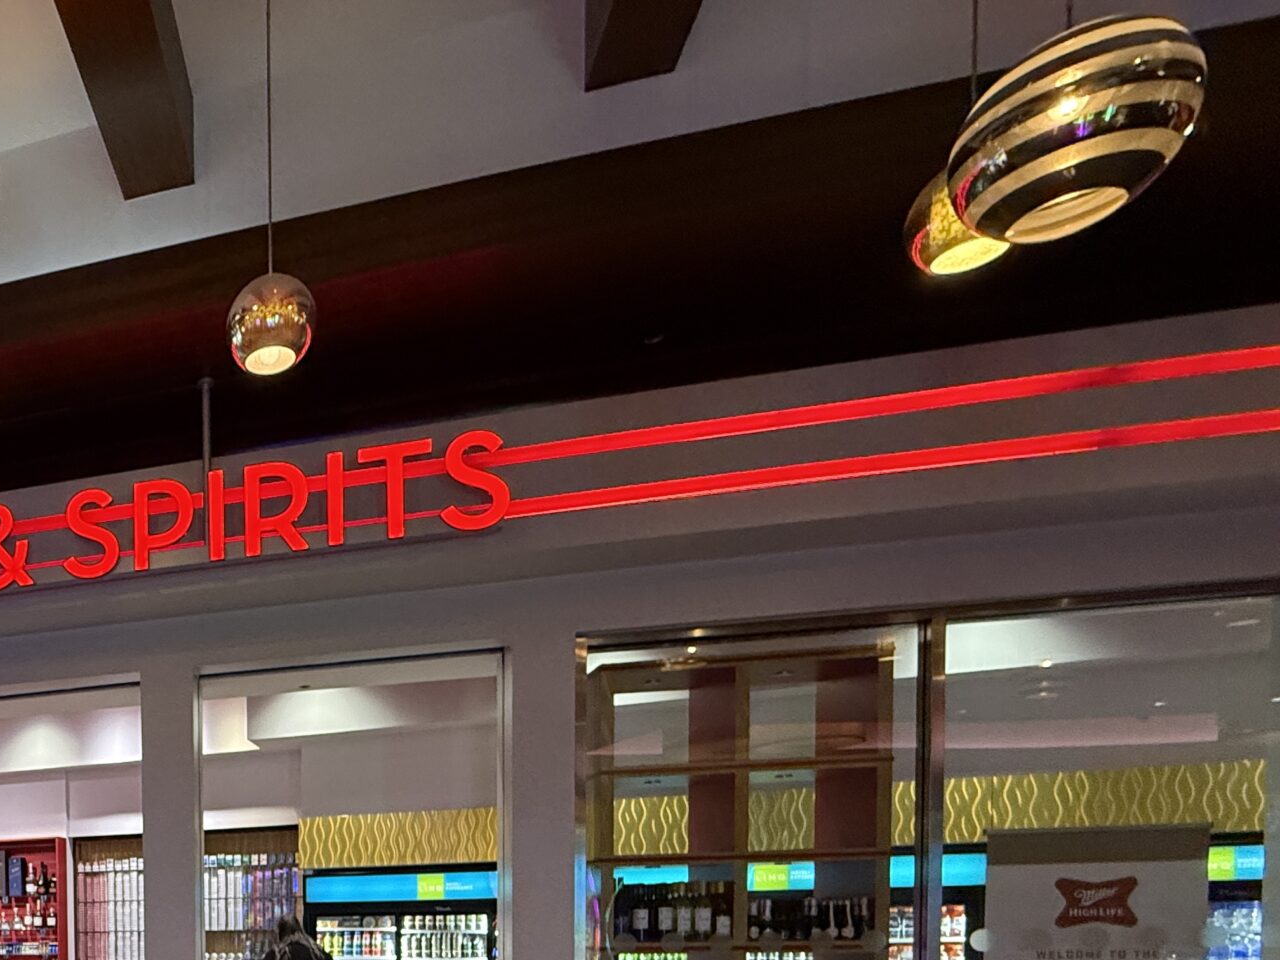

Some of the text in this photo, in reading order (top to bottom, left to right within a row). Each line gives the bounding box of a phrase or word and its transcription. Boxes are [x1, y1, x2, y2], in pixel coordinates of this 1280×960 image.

[63, 430, 511, 579] SPIRITS
[1074, 886, 1119, 907] Miller
[1069, 907, 1124, 917] HIGH LIFE
[1110, 950, 1125, 960] TO
